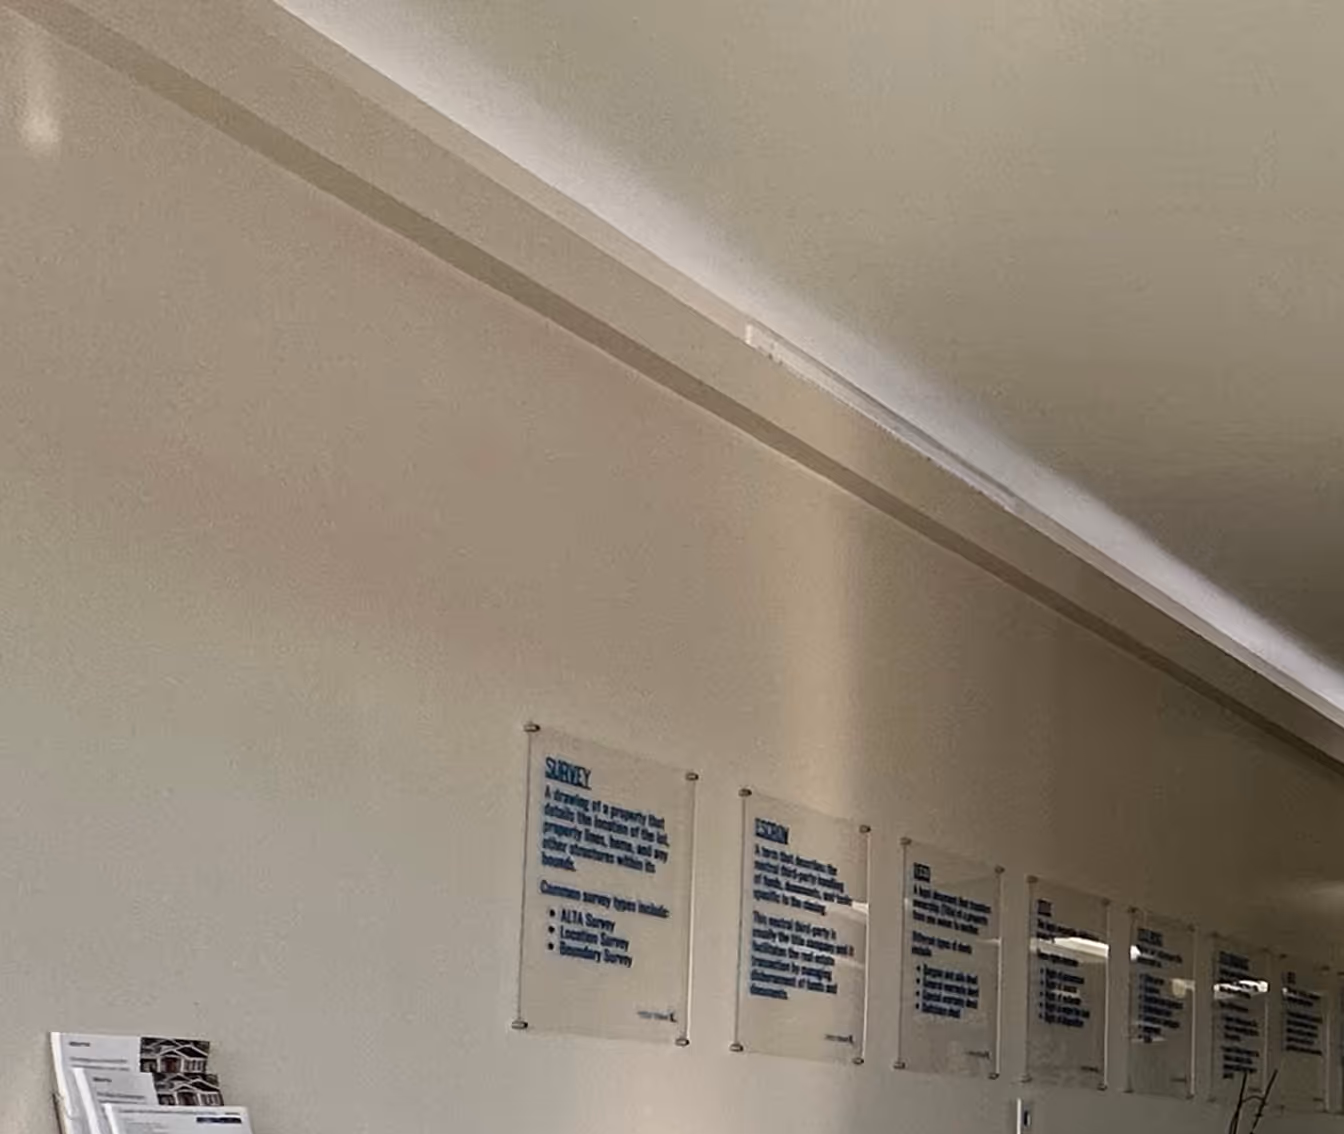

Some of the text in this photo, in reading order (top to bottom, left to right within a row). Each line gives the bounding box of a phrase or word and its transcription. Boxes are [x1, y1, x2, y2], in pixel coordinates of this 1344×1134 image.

[545, 756, 592, 790] SURVEY
[545, 785, 551, 798] A
[554, 789, 589, 812] drawing
[611, 806, 646, 827] property
[648, 814, 665, 830] that
[543, 821, 582, 841] property
[637, 845, 652, 857] and
[577, 811, 592, 826] the
[594, 814, 628, 835] location
[630, 826, 639, 837] of
[641, 828, 655, 842] the
[540, 880, 581, 900] Common
[583, 891, 611, 909] survey
[613, 896, 636, 912] types
[560, 909, 615, 933] ALTA Survey
[560, 925, 629, 952] Location Survey
[559, 941, 633, 968] Boundary Survey
